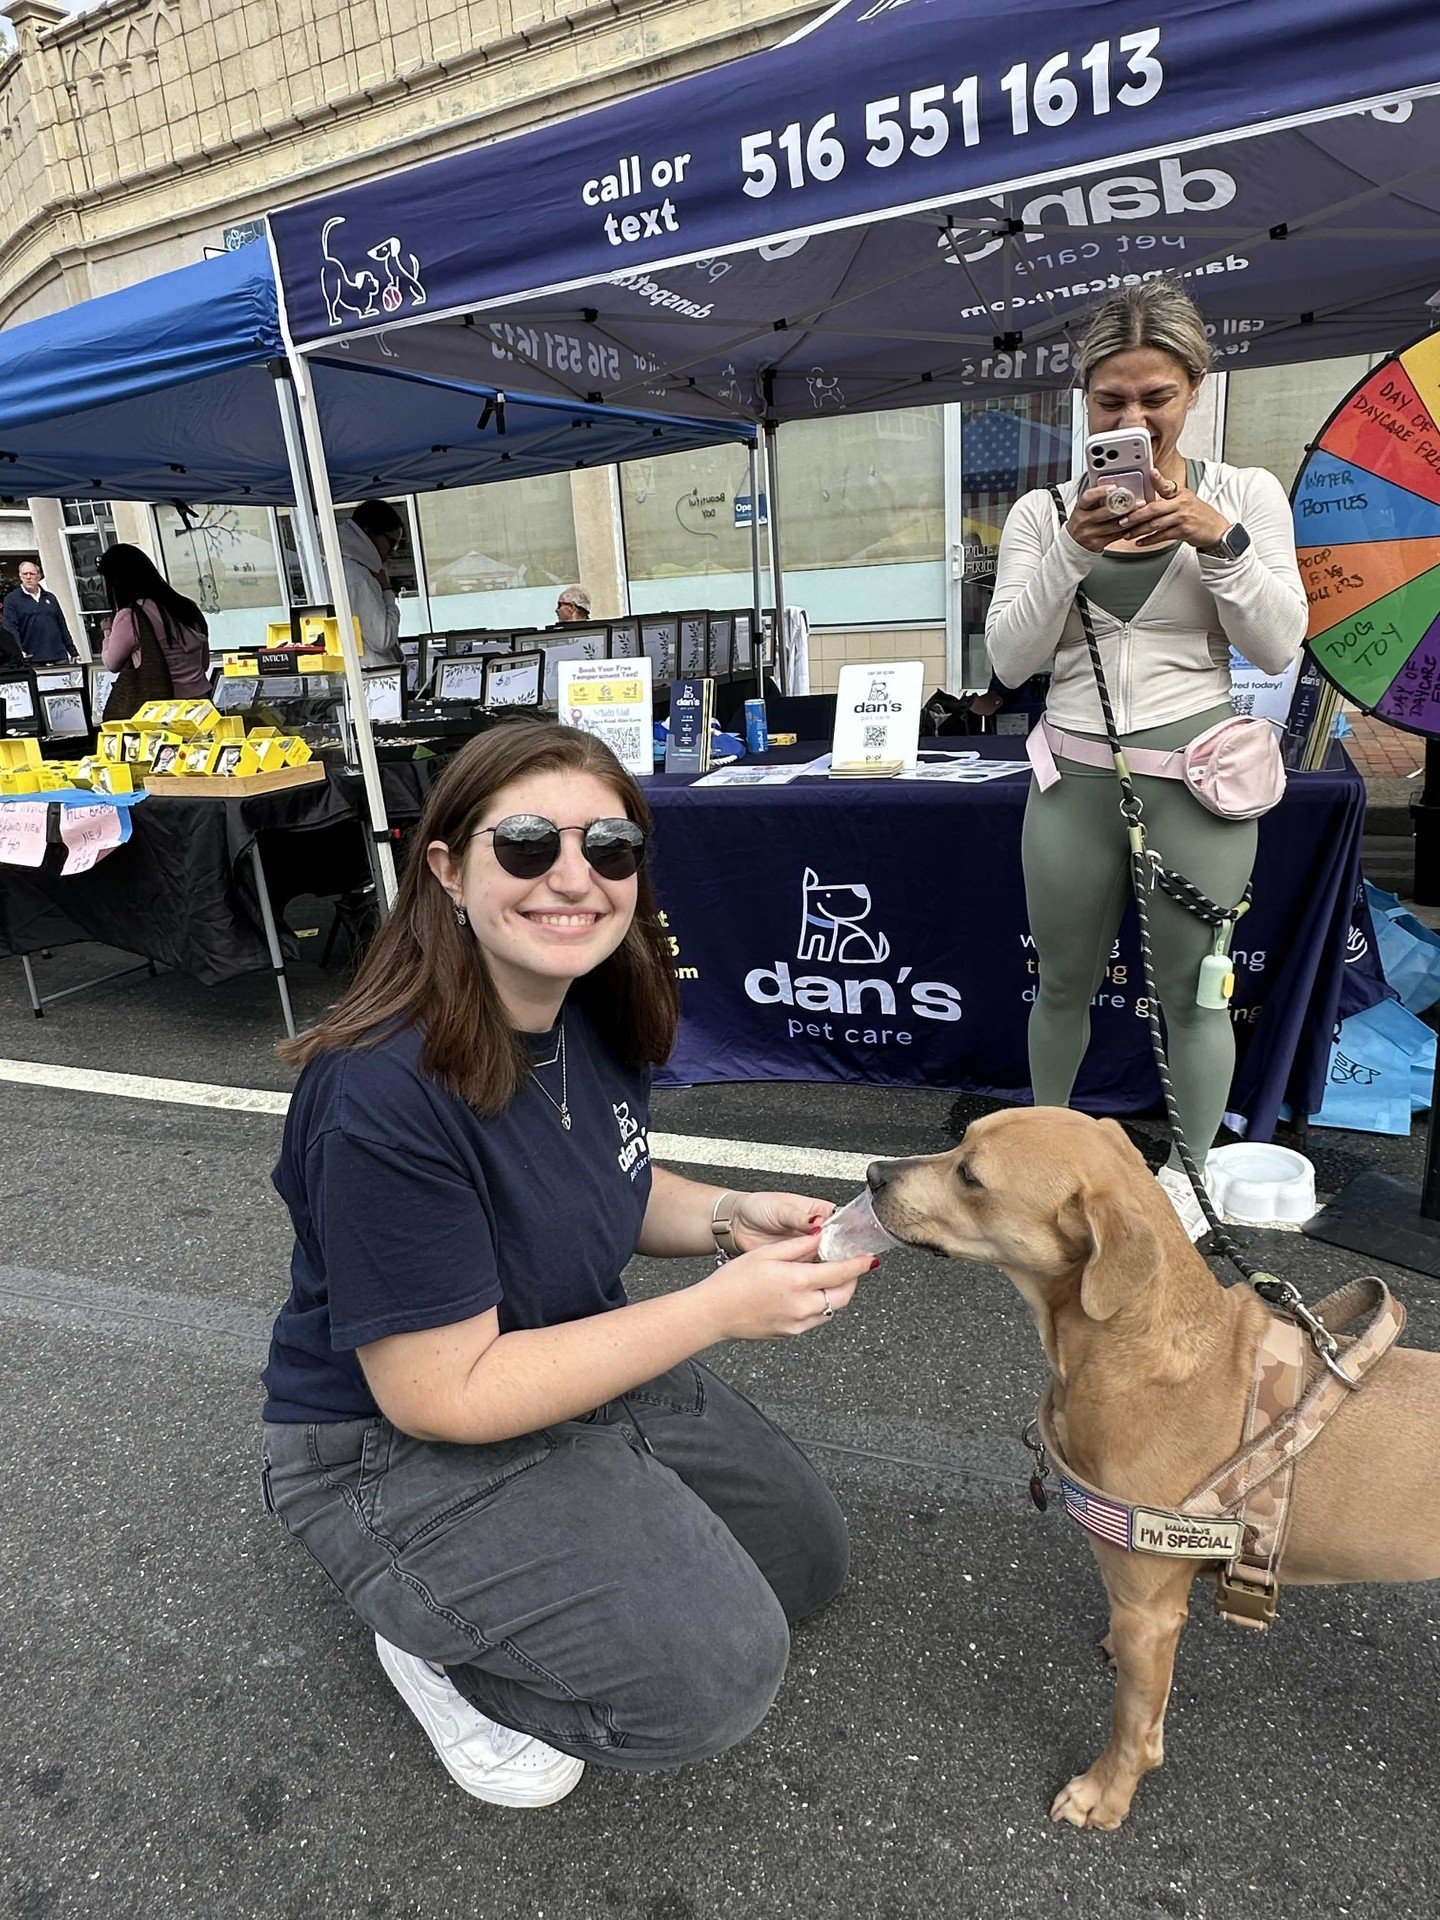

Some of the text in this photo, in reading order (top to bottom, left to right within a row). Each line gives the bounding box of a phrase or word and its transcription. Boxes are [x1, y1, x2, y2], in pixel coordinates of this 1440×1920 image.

[741, 27, 1164, 198] 516 551 1613
[582, 152, 692, 206] call or
[604, 198, 680, 246] text
[1353, 394, 1415, 442] DAYCARE
[1380, 381, 1434, 432] DAY OF
[1304, 470, 1355, 491] WATER
[735, 503, 752, 512] Ope
[1299, 493, 1369, 518] BOTTLES
[1325, 621, 1375, 659] DOG
[1353, 622, 1404, 667] TOY
[261, 653, 290, 664] INVICTA
[578, 666, 597, 674] Book
[1251, 681, 1283, 690] today!
[676, 697, 701, 707] dan's
[853, 700, 903, 714] dan's
[744, 961, 962, 1022] dan's
[787, 1017, 913, 1045] pet care
[1140, 1527, 1232, 1549] I'M SPECIAL
